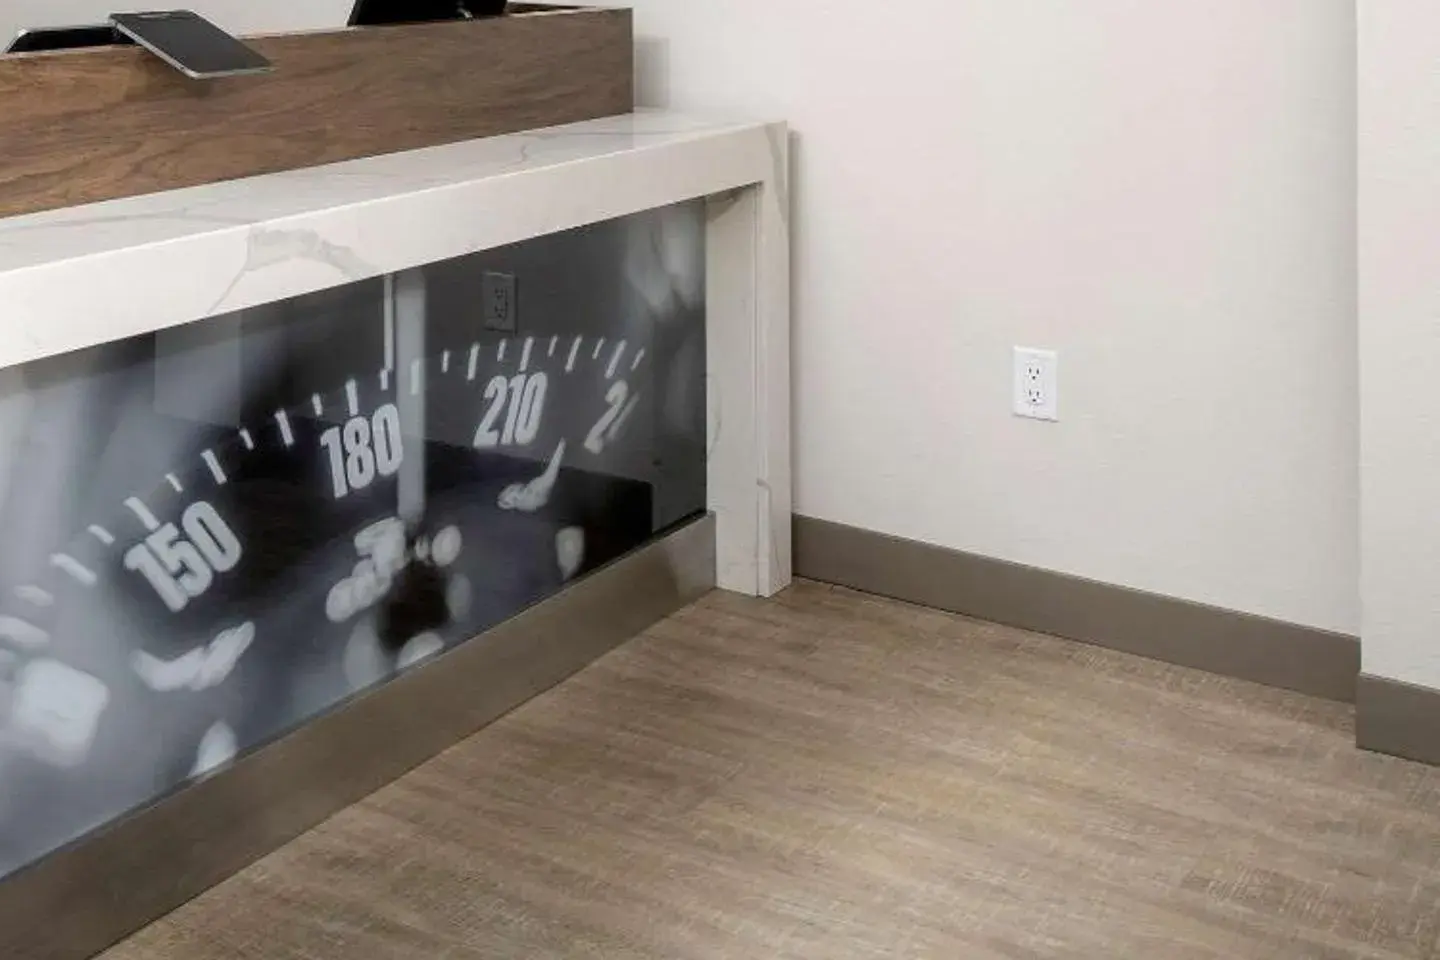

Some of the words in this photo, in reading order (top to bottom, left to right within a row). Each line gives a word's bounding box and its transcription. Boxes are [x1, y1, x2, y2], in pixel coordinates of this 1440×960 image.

[123, 500, 243, 613] 150
[319, 402, 404, 499] 180
[473, 371, 548, 449] 210
